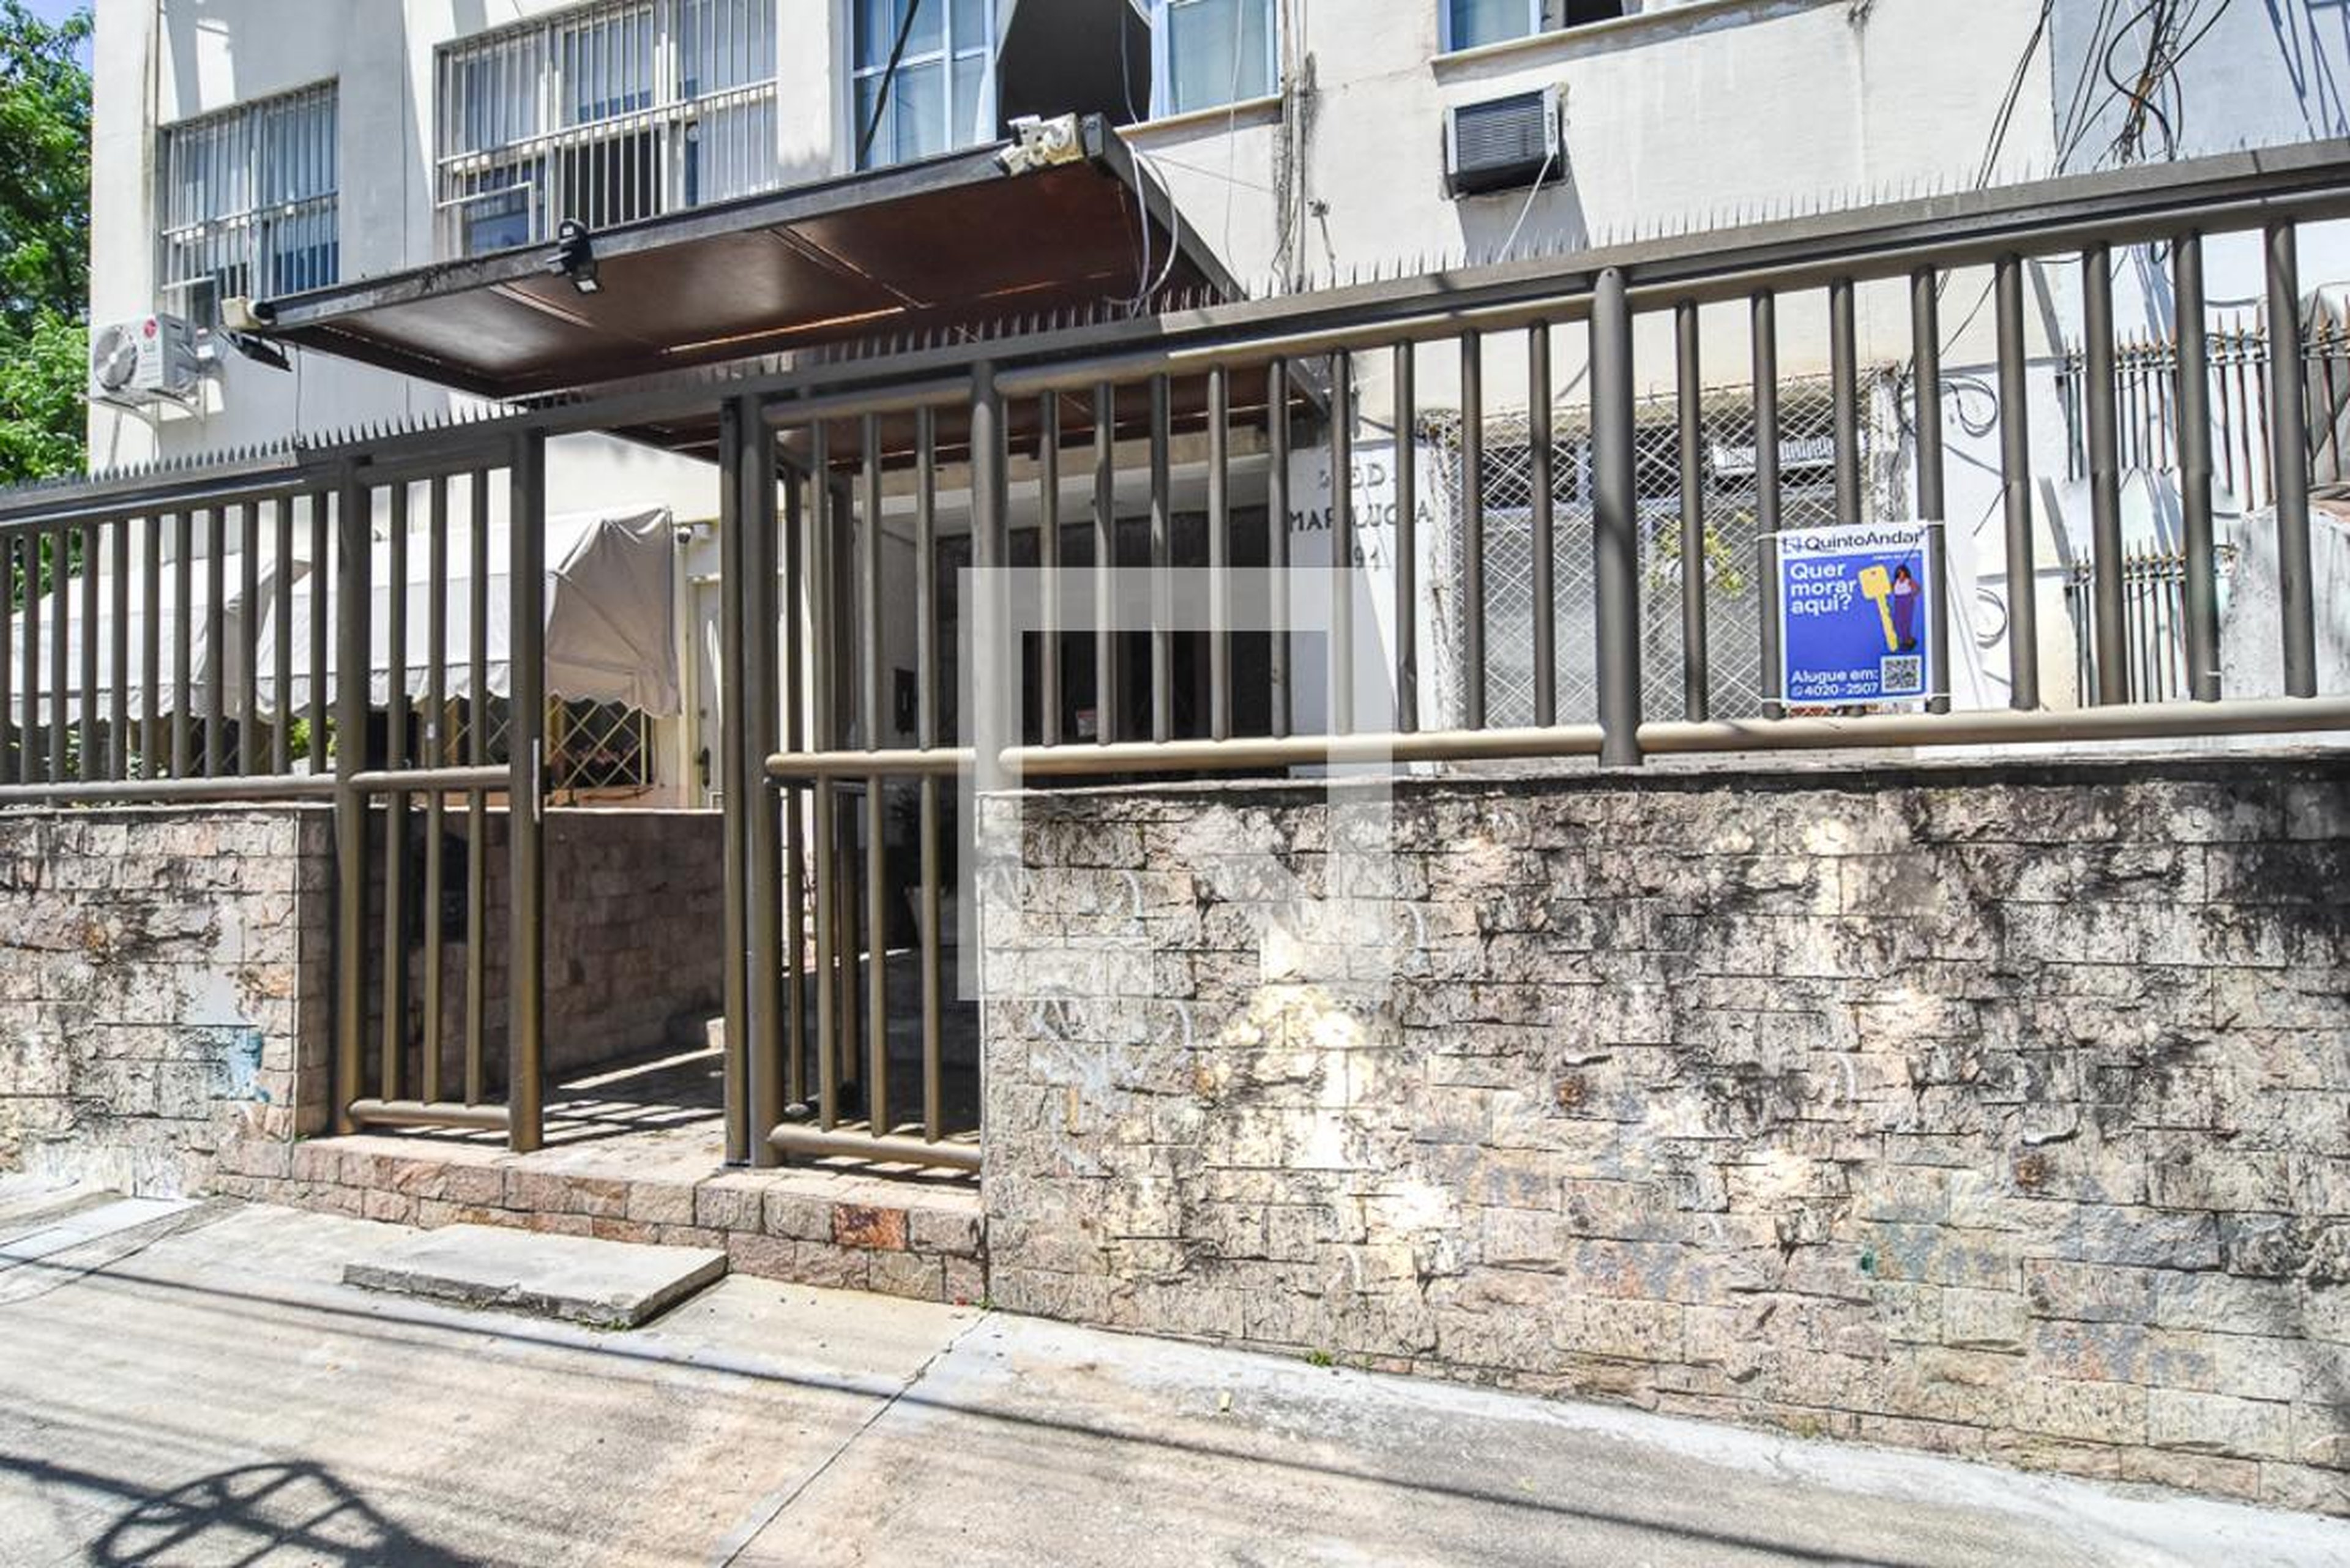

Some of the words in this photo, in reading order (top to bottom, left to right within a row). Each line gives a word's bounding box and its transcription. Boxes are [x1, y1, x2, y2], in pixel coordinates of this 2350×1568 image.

[1805, 531, 1920, 551] QuintoAndar
[1790, 562, 1846, 581] Quer
[1791, 579, 1857, 596] morar
[1791, 595, 1852, 615] aqui?
[1791, 670, 1847, 685] Alugue
[1849, 669, 1879, 681] em:
